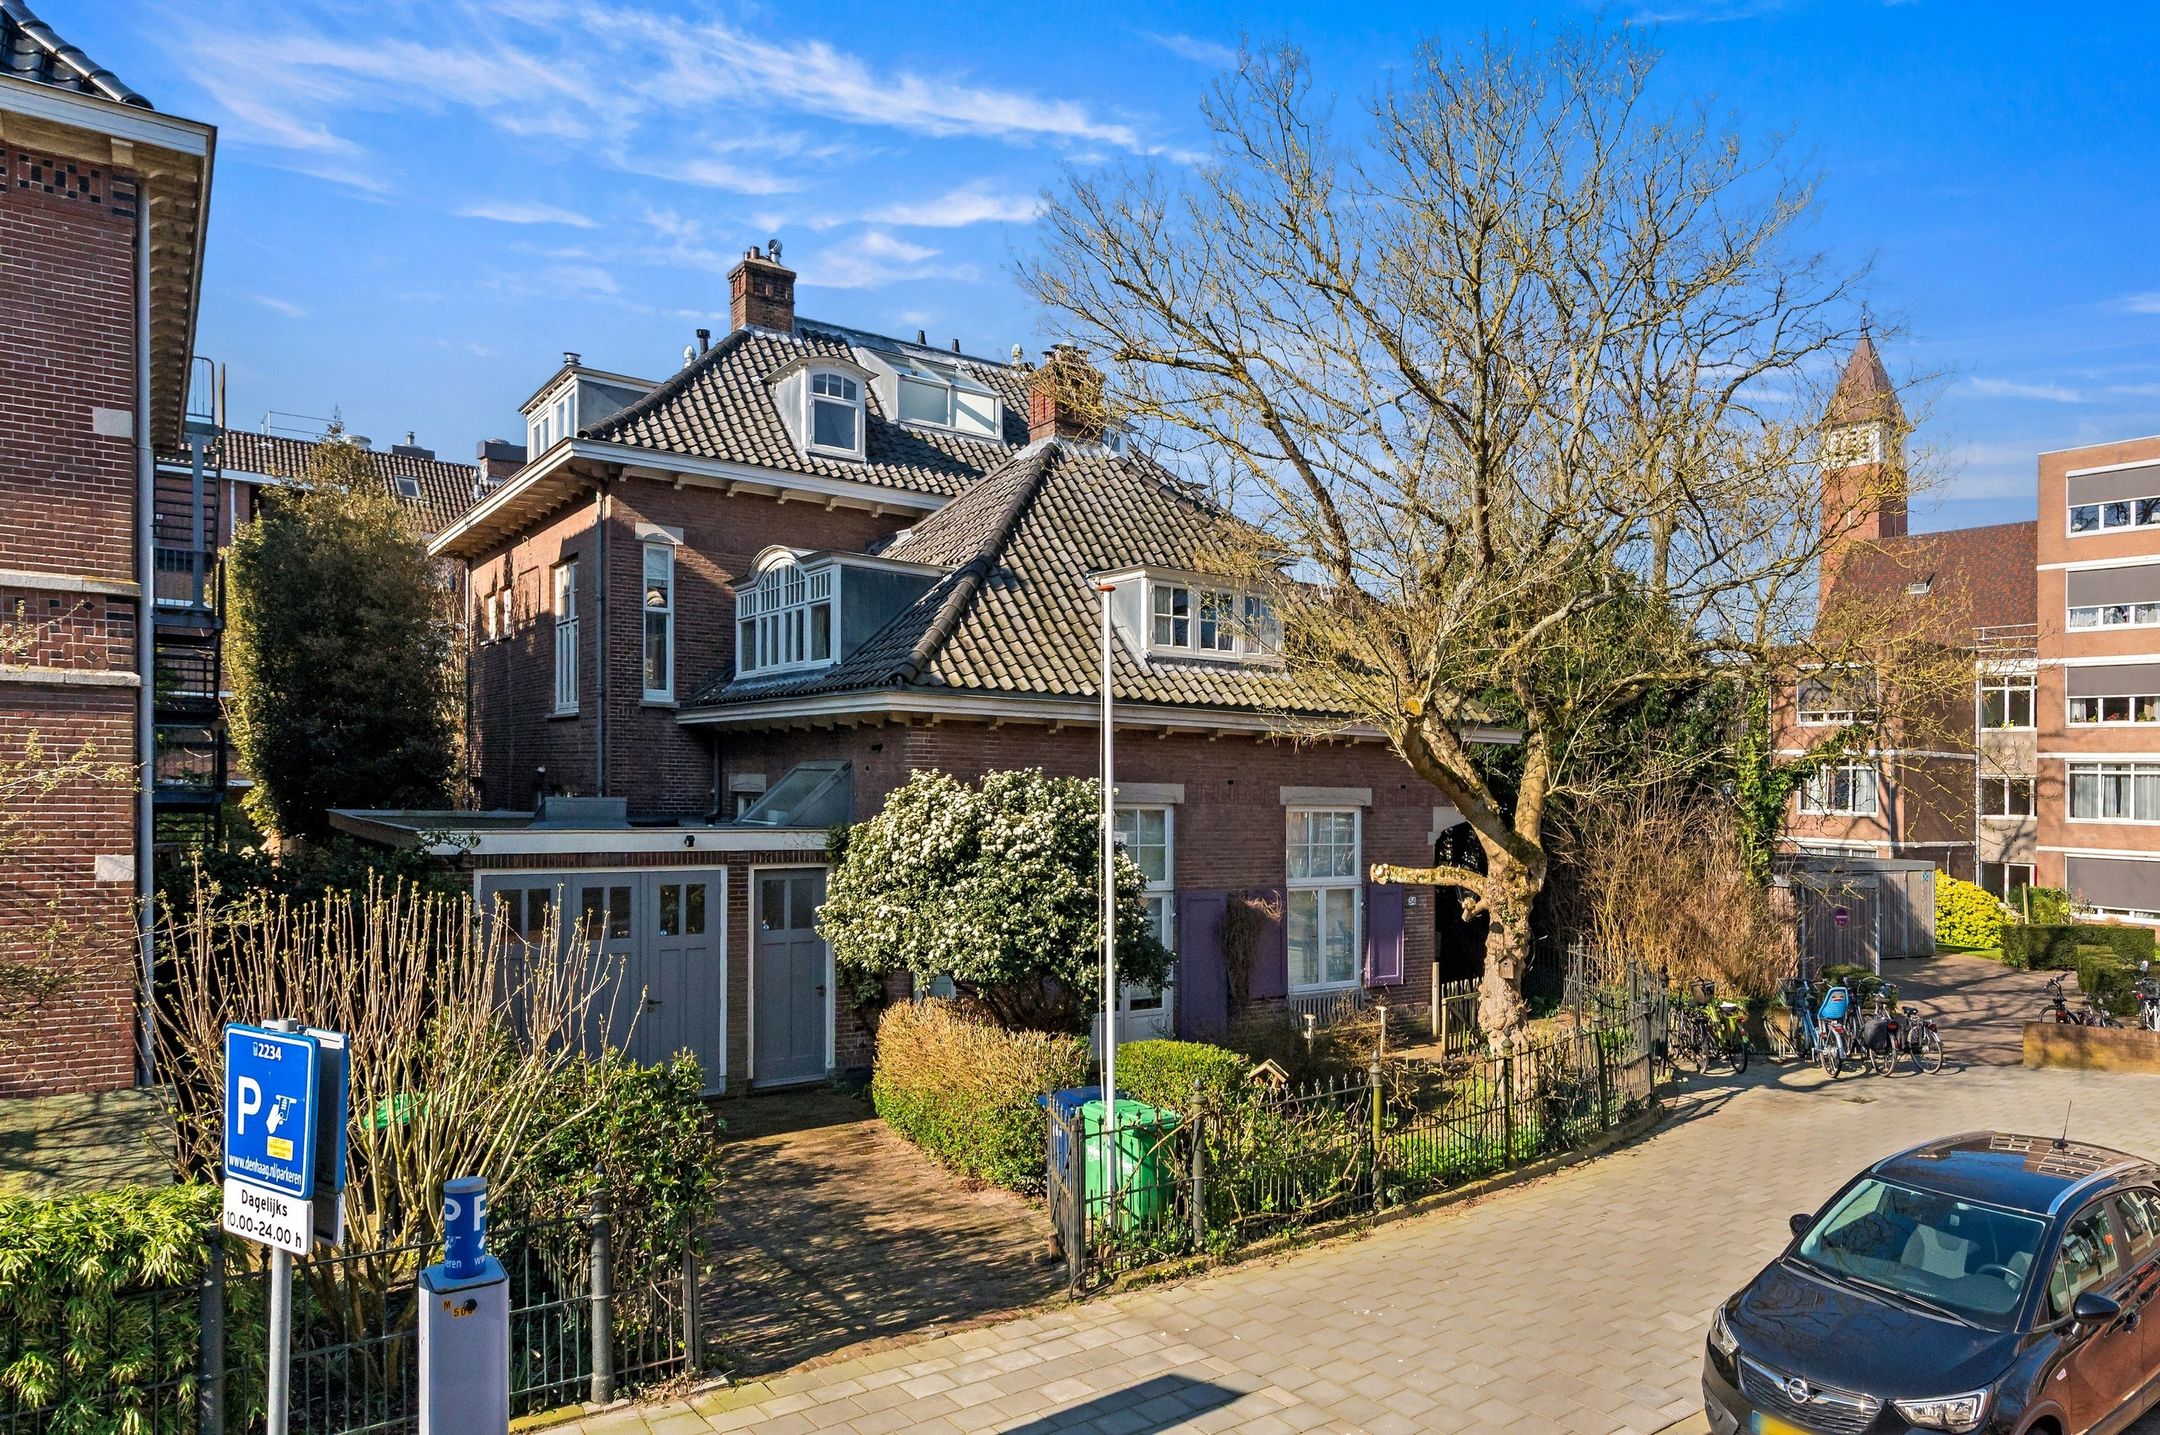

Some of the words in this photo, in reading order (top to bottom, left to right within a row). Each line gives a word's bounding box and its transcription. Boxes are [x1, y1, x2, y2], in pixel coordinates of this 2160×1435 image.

[258, 1043, 282, 1061] 2234
[237, 1075, 262, 1135] P
[229, 1155, 302, 1186] www.denhaag.nl/parkeren
[241, 1189, 288, 1218] Dagelijks
[227, 1211, 291, 1245] 10.00-24.00
[295, 1232, 302, 1249] h
[443, 1301, 451, 1310] M
